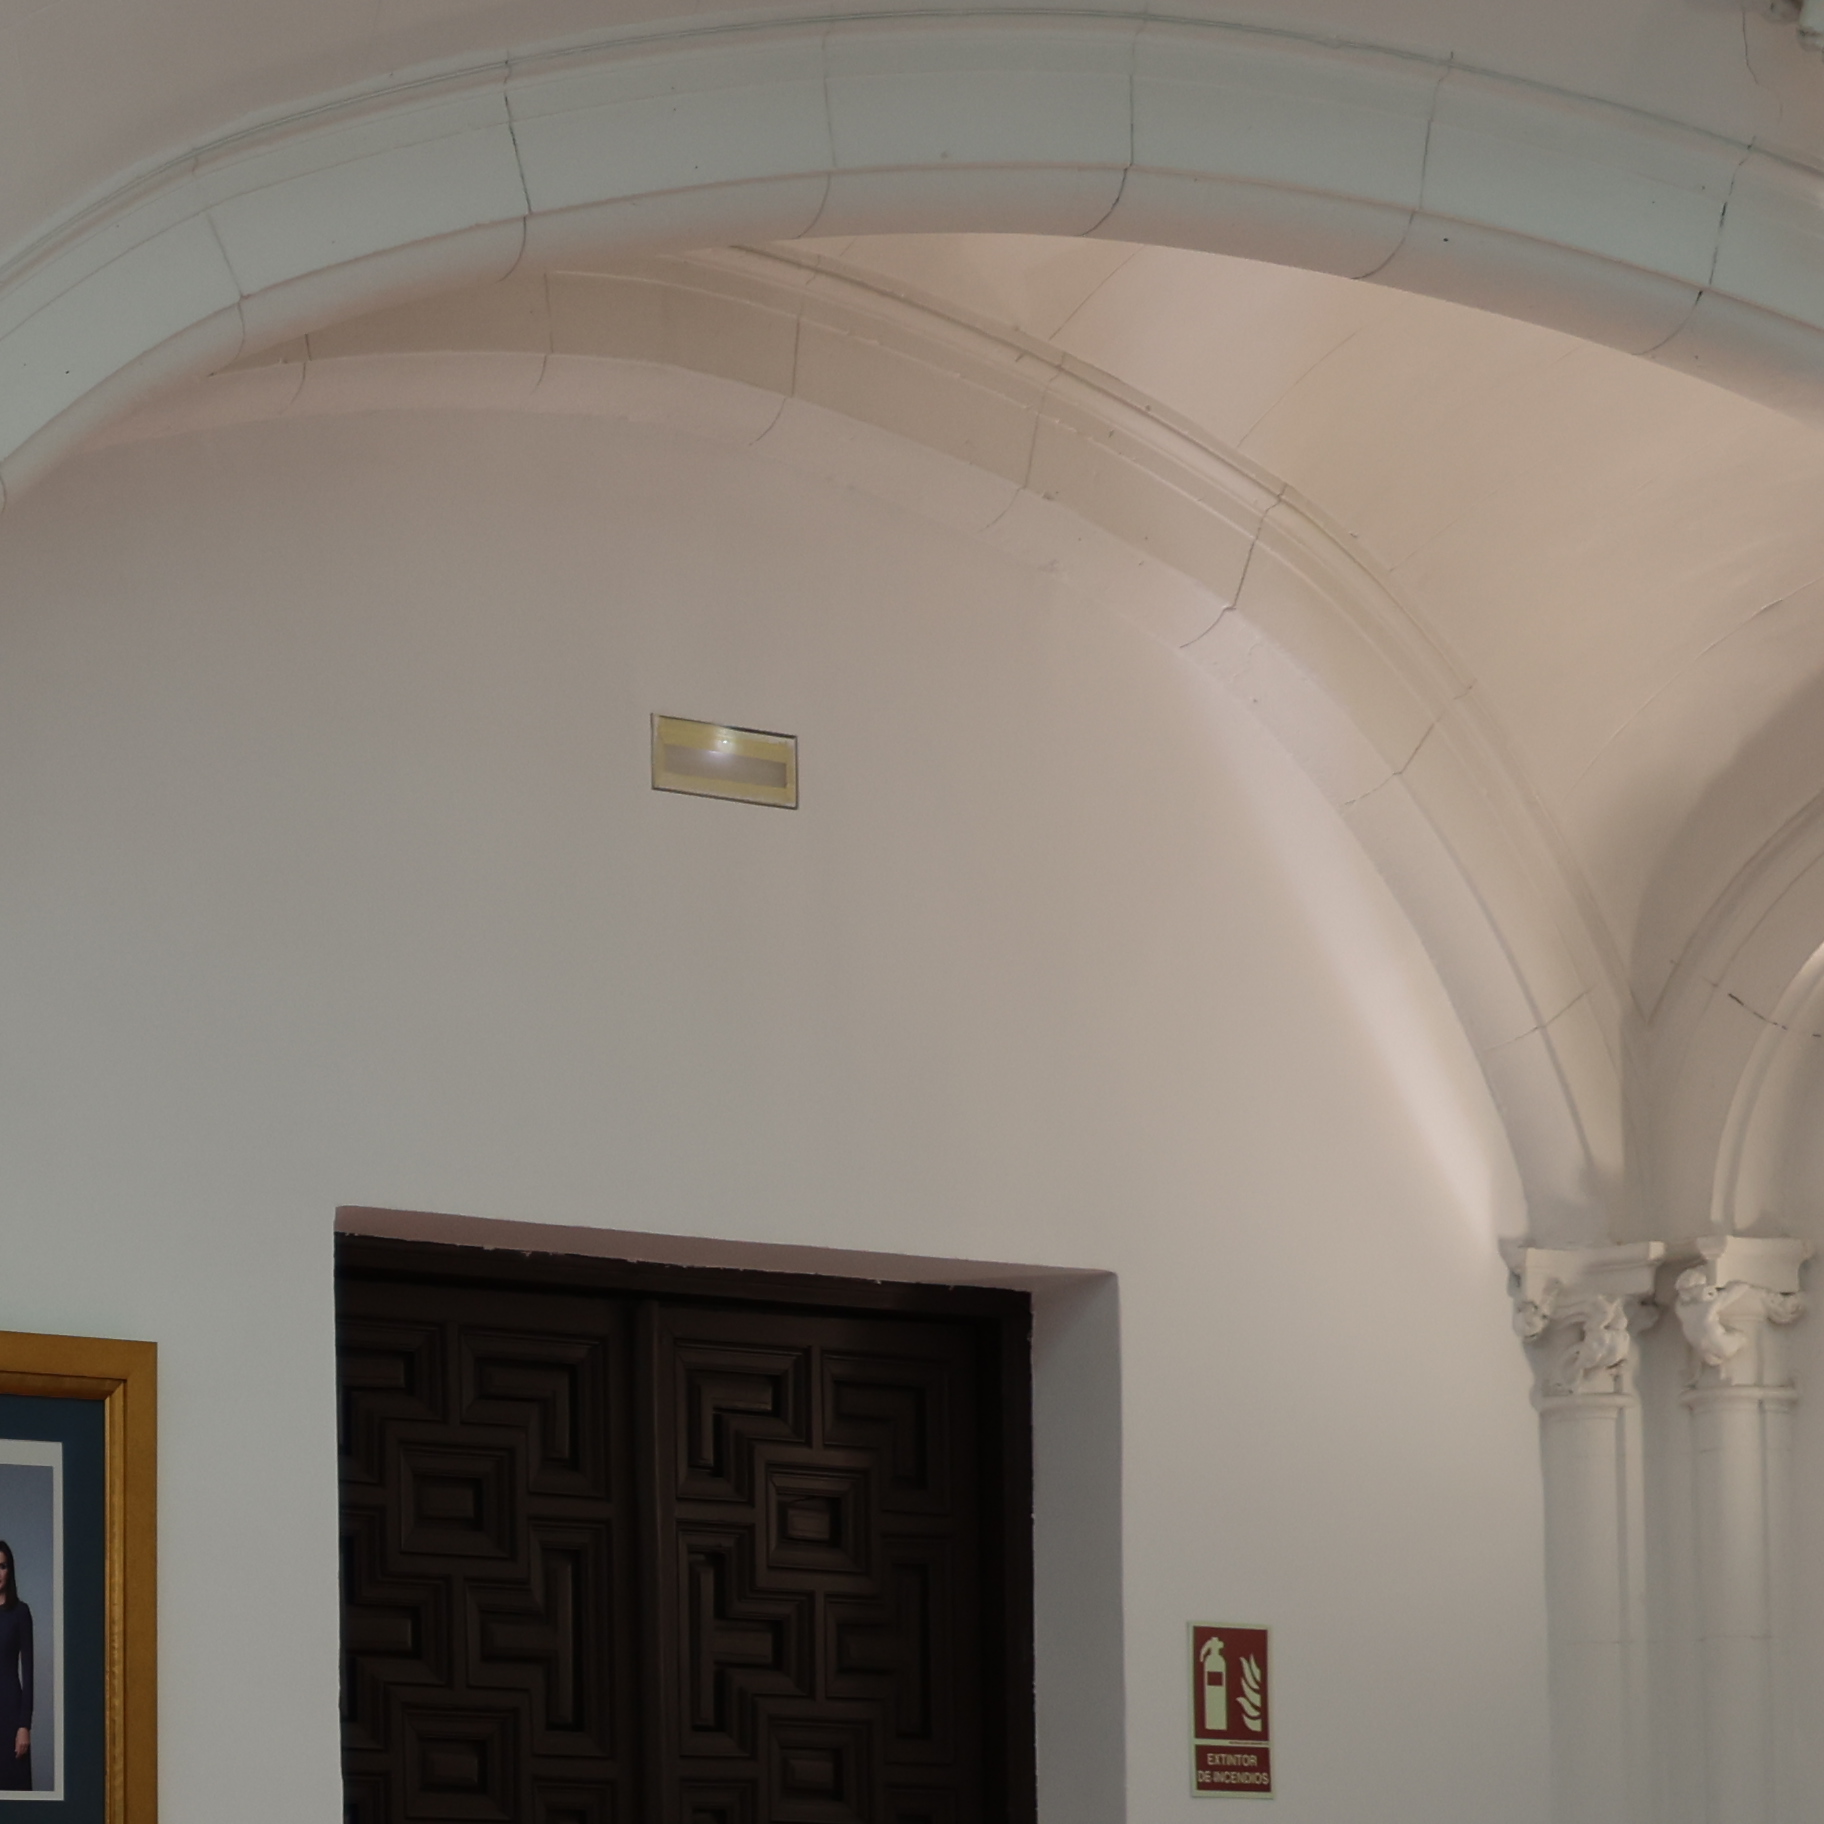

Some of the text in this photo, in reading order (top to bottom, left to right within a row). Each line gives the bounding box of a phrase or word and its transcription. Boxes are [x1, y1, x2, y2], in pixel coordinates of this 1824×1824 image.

[1206, 1753, 1258, 1767] EXTINTOR
[1197, 1770, 1270, 1786] DE INCENDIOS
